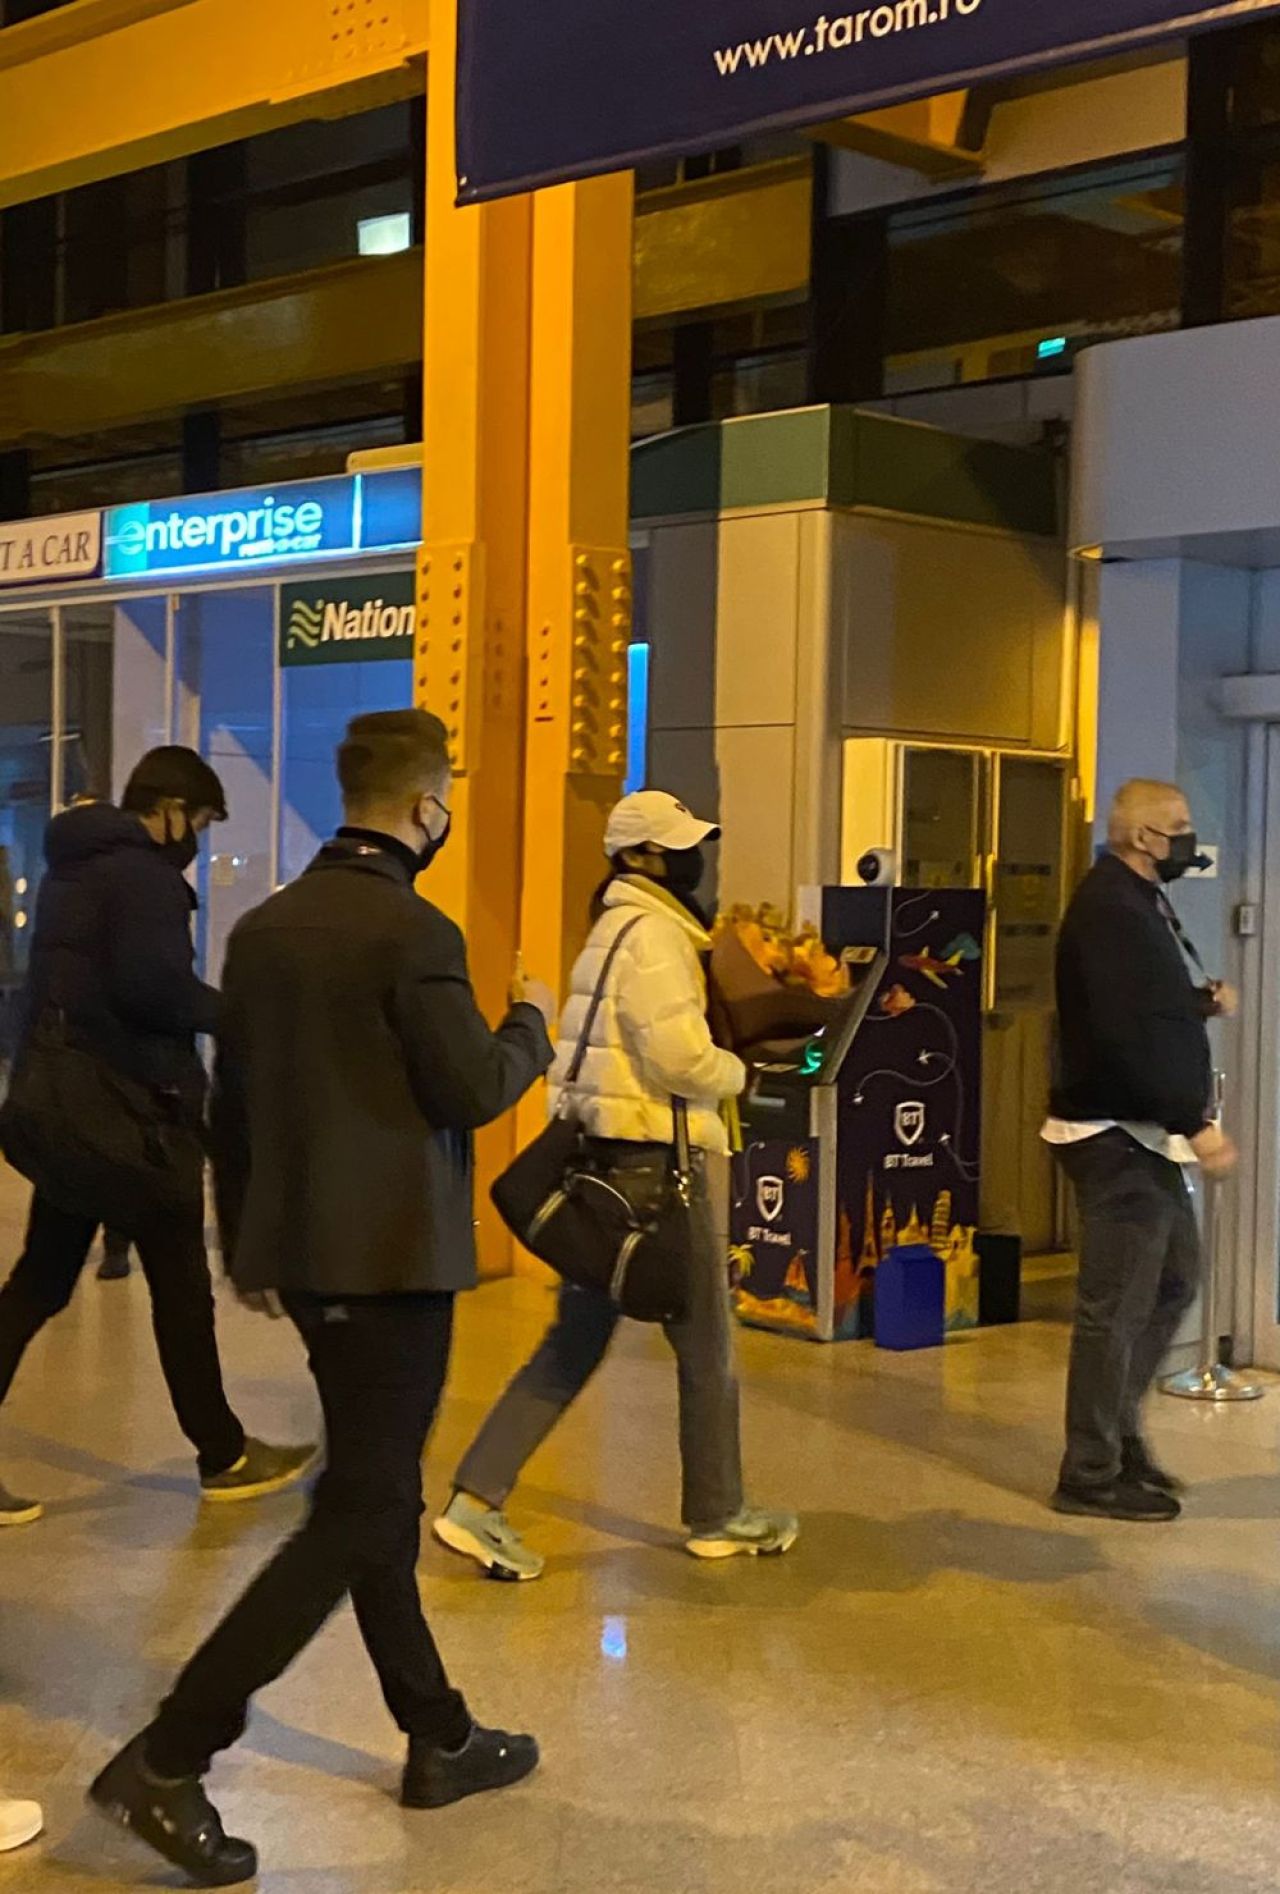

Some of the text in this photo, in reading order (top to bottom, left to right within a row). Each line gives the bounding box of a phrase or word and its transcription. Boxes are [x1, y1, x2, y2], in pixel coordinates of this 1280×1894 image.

[105, 496, 323, 555] enterprise
[17, 539, 34, 569] A
[42, 531, 91, 566] CAR
